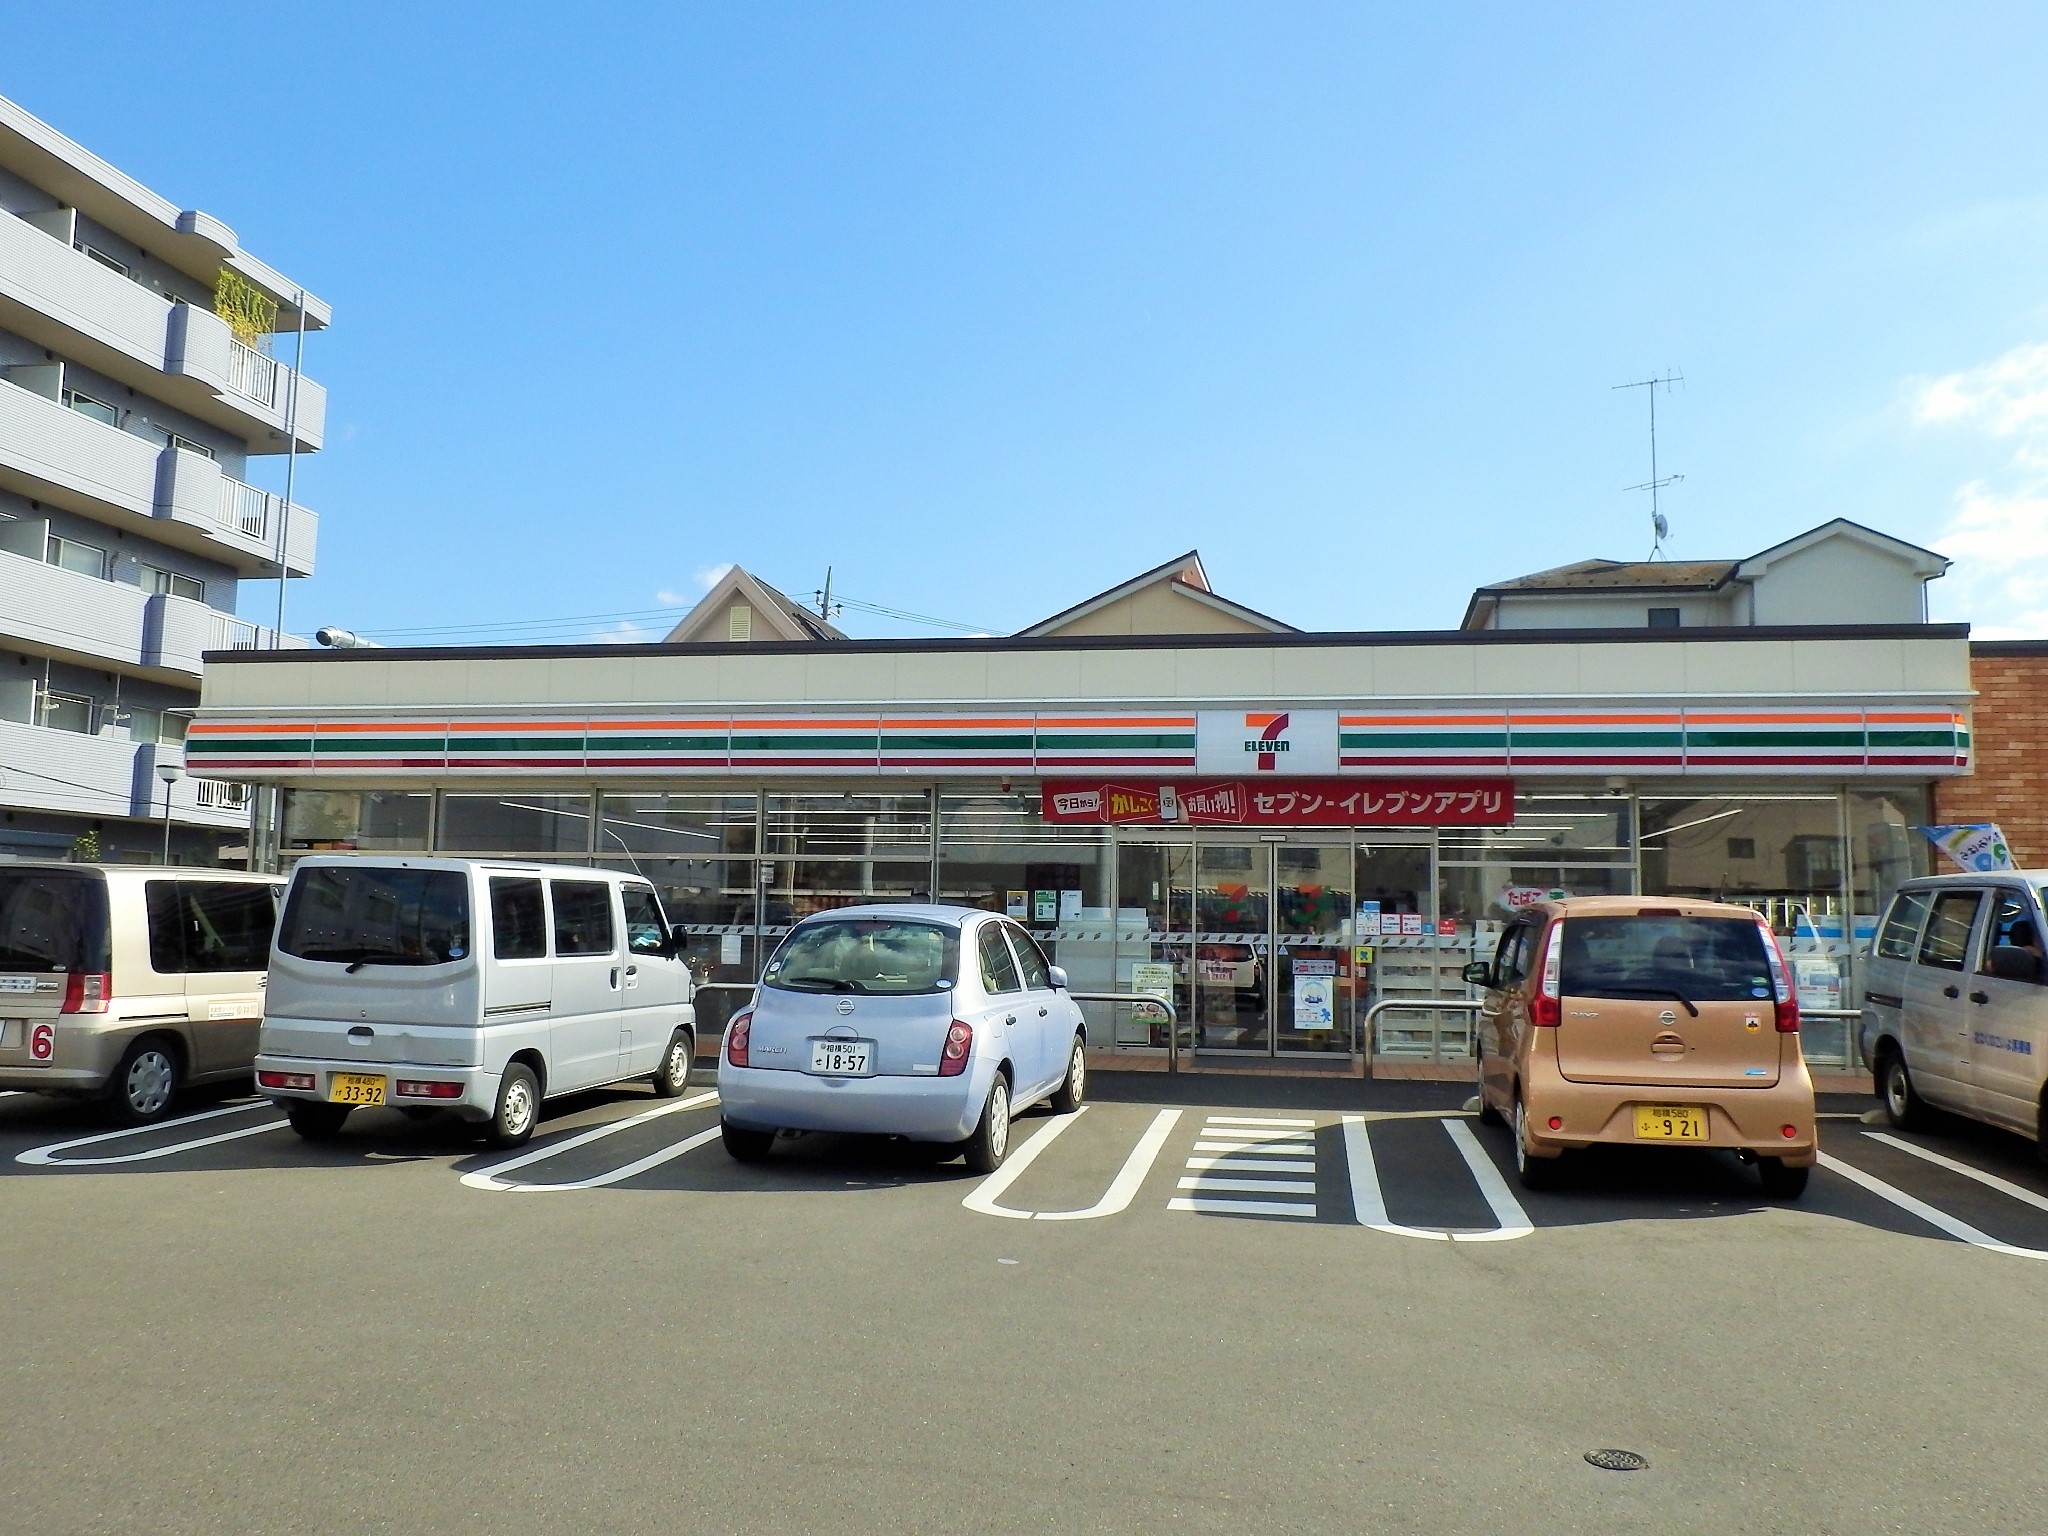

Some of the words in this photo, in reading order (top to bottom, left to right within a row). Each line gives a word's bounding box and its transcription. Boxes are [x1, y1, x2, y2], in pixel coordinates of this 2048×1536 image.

[1246, 713, 1289, 770] 7
[1111, 793, 1153, 815] かしこく
[1188, 790, 1236, 814] お買い物!
[32, 1025, 53, 1058] 6
[825, 1054, 866, 1071] 18-57
[343, 1086, 381, 1102] 33-92
